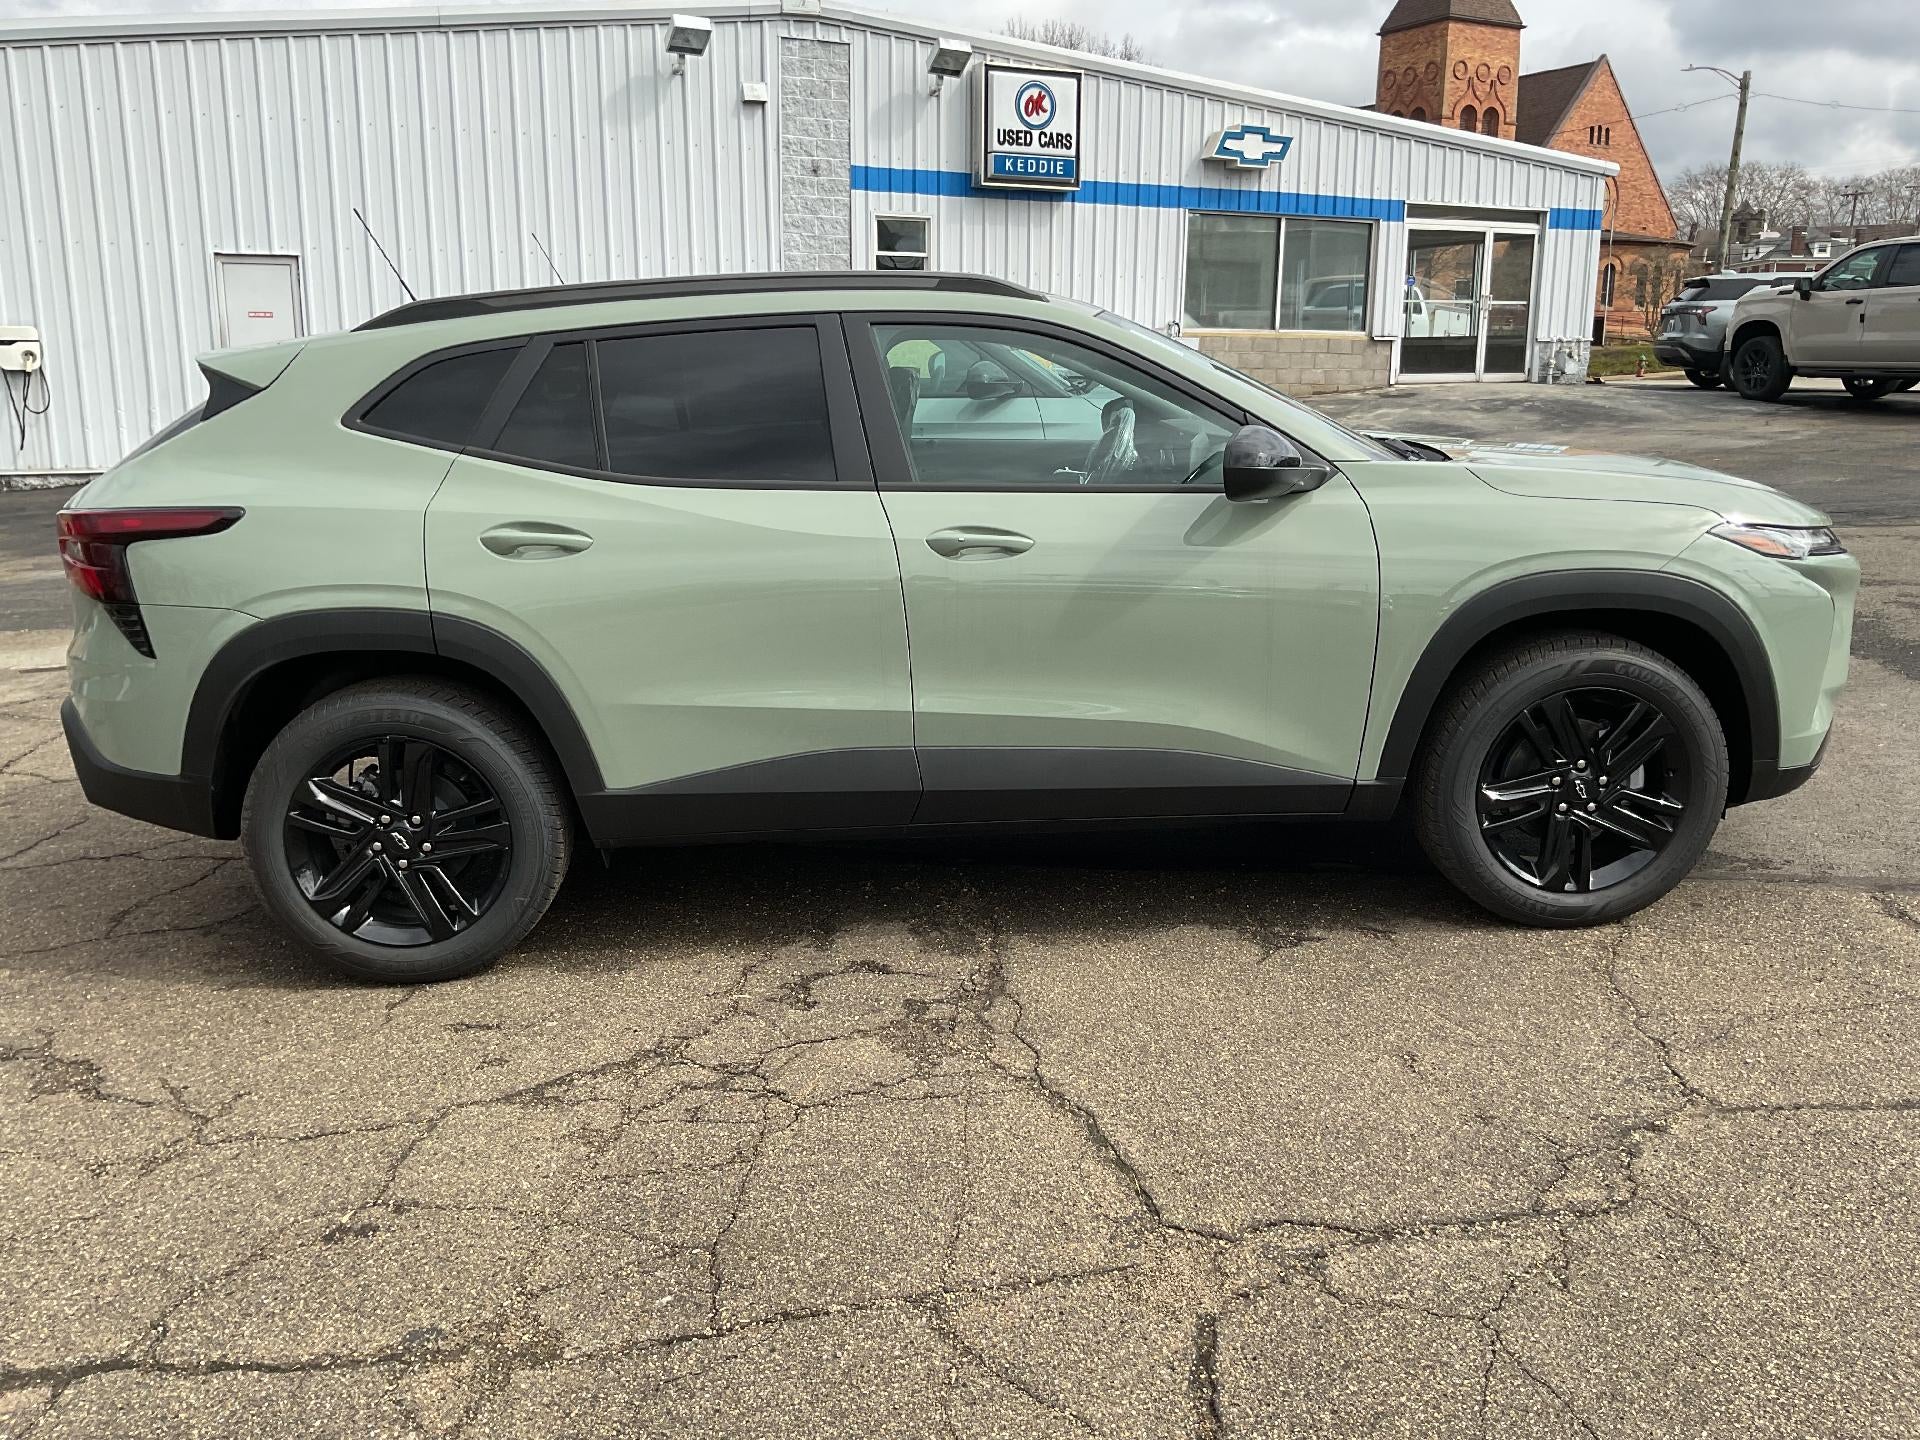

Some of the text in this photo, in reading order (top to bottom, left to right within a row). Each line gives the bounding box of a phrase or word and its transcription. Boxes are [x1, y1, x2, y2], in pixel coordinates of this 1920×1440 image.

[1024, 90, 1049, 118] OK
[997, 128, 1073, 151] USED CARS
[1005, 158, 1065, 175] KEDDIE
